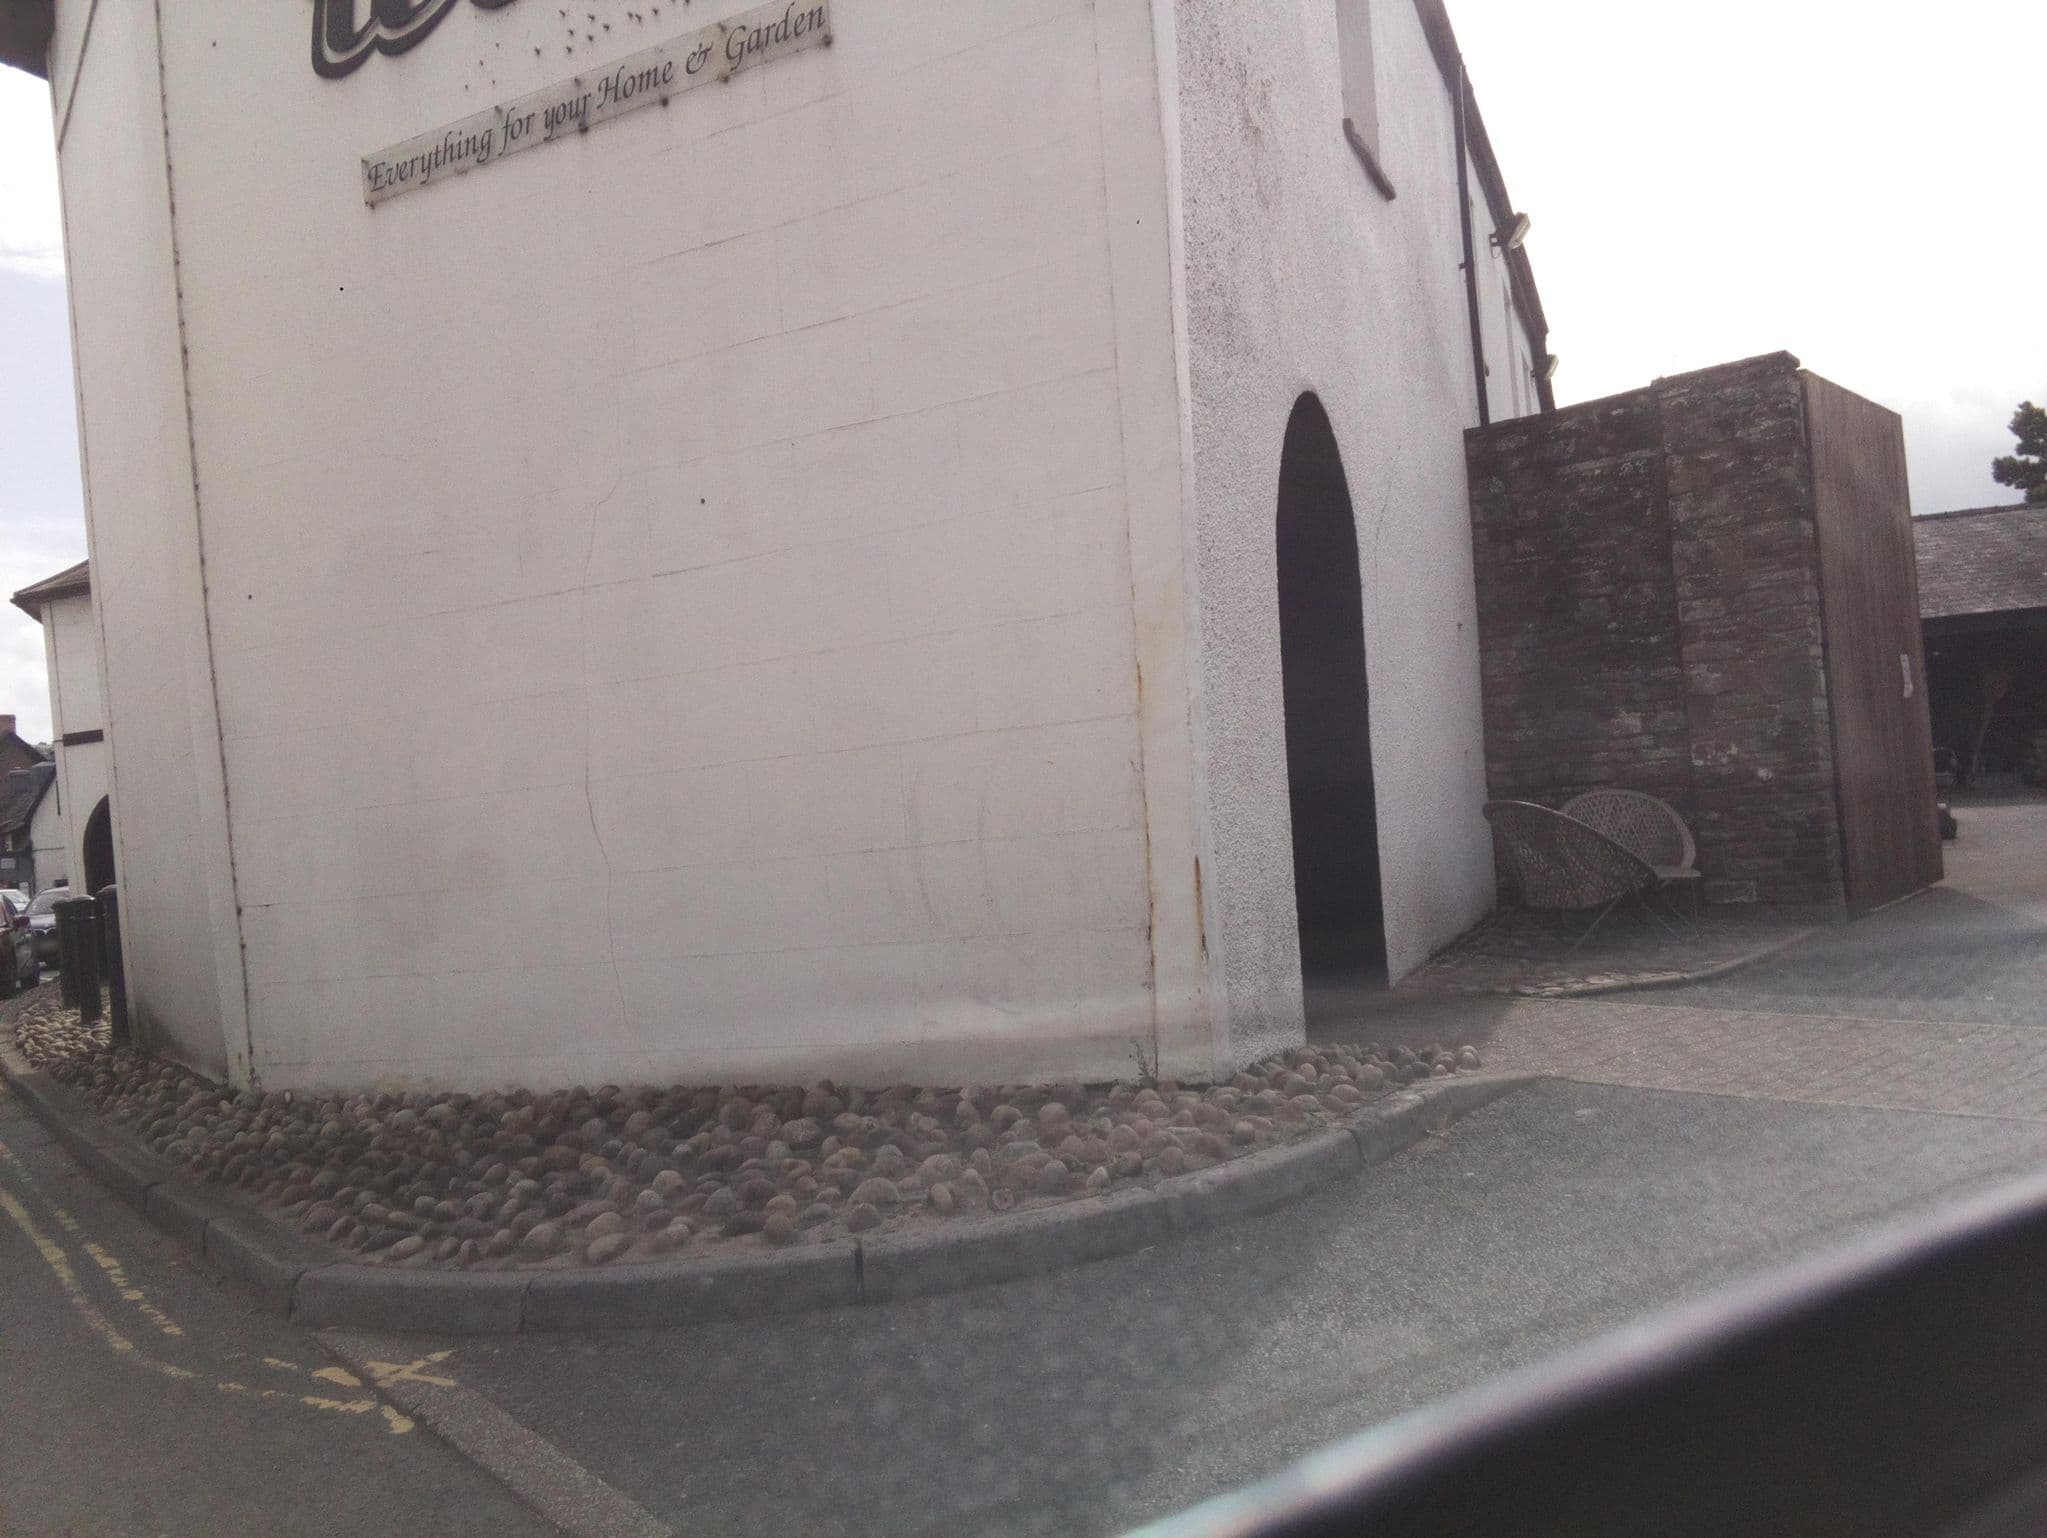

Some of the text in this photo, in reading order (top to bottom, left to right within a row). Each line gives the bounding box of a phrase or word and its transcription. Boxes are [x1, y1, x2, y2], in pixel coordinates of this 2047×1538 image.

[368, 2, 826, 192] Everything for your Home & Garden
